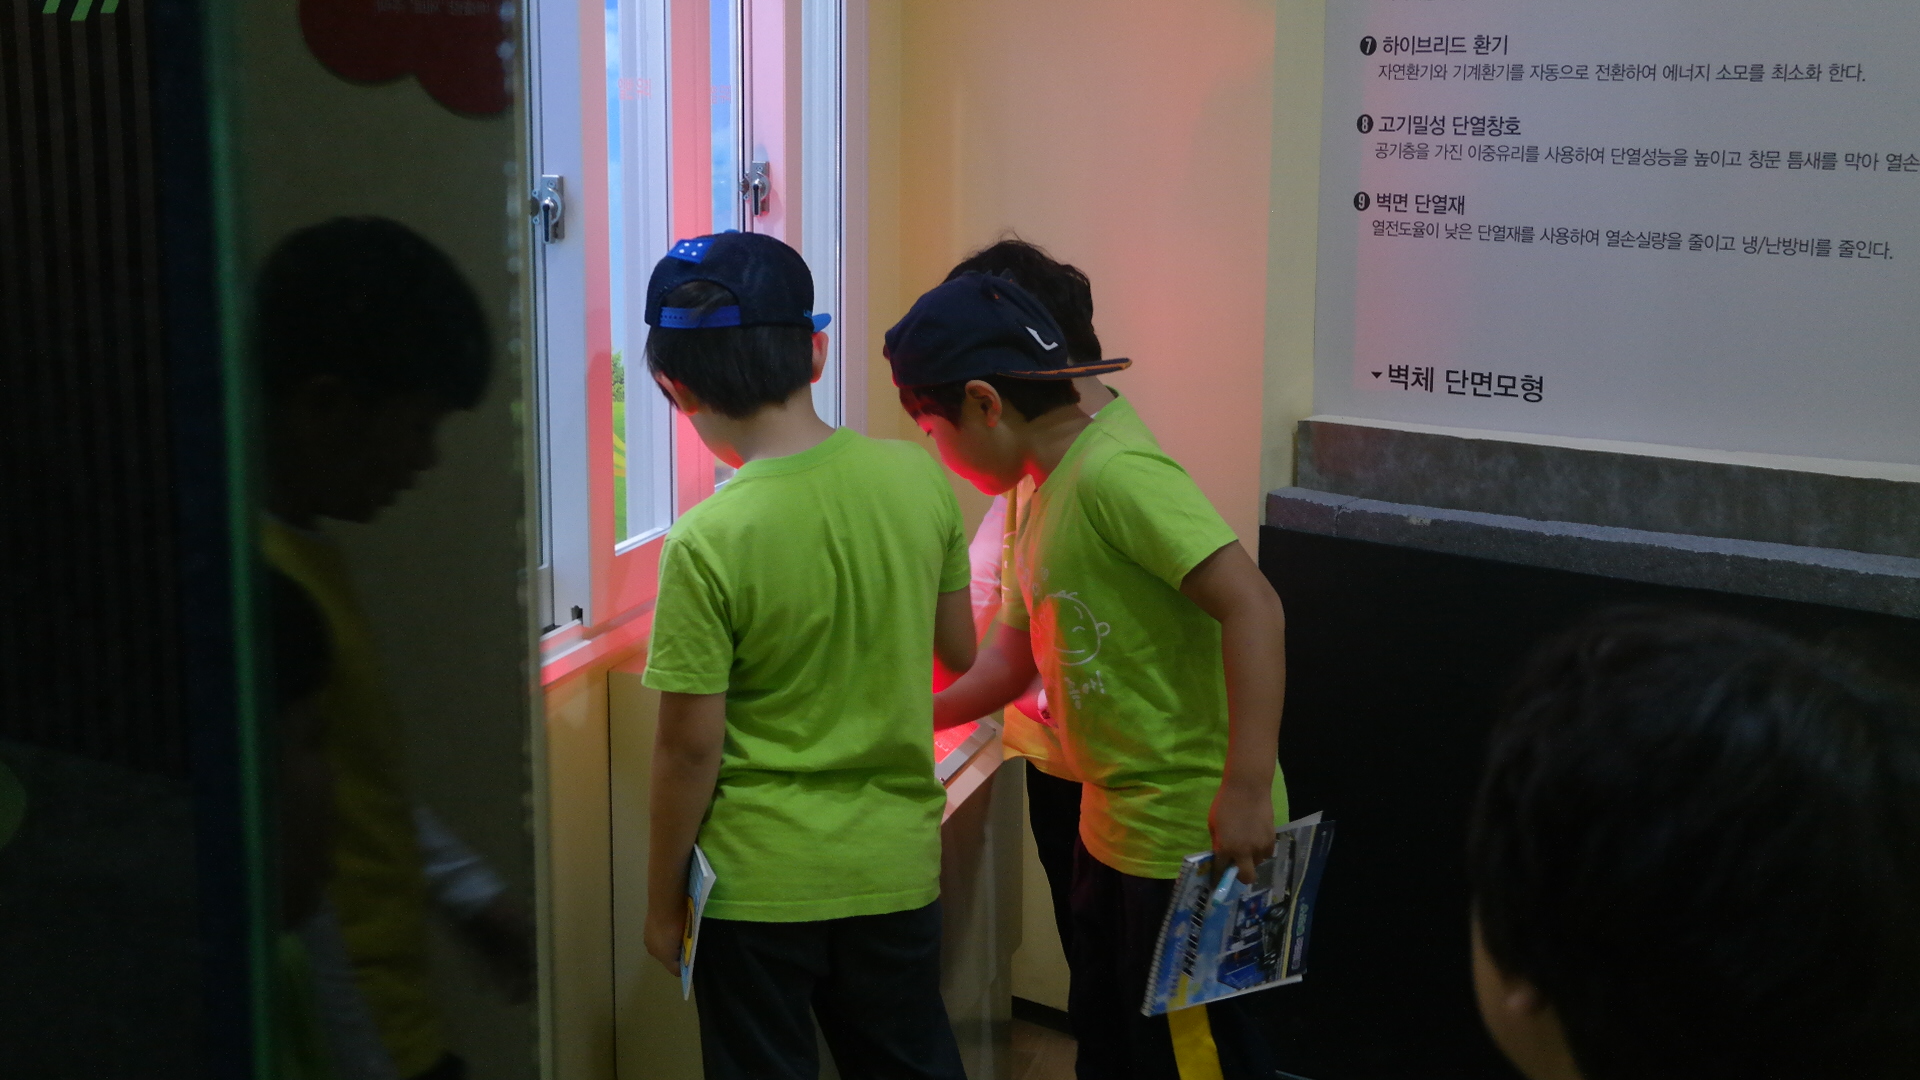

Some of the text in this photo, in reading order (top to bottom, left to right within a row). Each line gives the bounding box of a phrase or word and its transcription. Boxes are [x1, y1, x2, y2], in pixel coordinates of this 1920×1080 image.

[1382, 34, 1468, 57] 하이브리드
[1472, 34, 1508, 56] 환기
[1377, 62, 1866, 83] 자연환기와 기계환기를 자동으로 전환하여 에너지 소모를 최소화 한다.
[1377, 114, 1446, 137] 고기밀성
[1452, 115, 1522, 138] 단열창호
[1374, 141, 1920, 173] 공기층을 가진 이중유리를 사용하여 단열성능을 높이고 창문 틈새를 막아 열손
[1376, 192, 1409, 214] 벽면
[1414, 193, 1466, 216] 단열재
[1371, 219, 1893, 260] 열전도율이 낮은 단열재를 사용하여 열손실량을 줄이고 냉/난방비를 줄인다.
[1387, 363, 1544, 404] 벽체 단면모형
